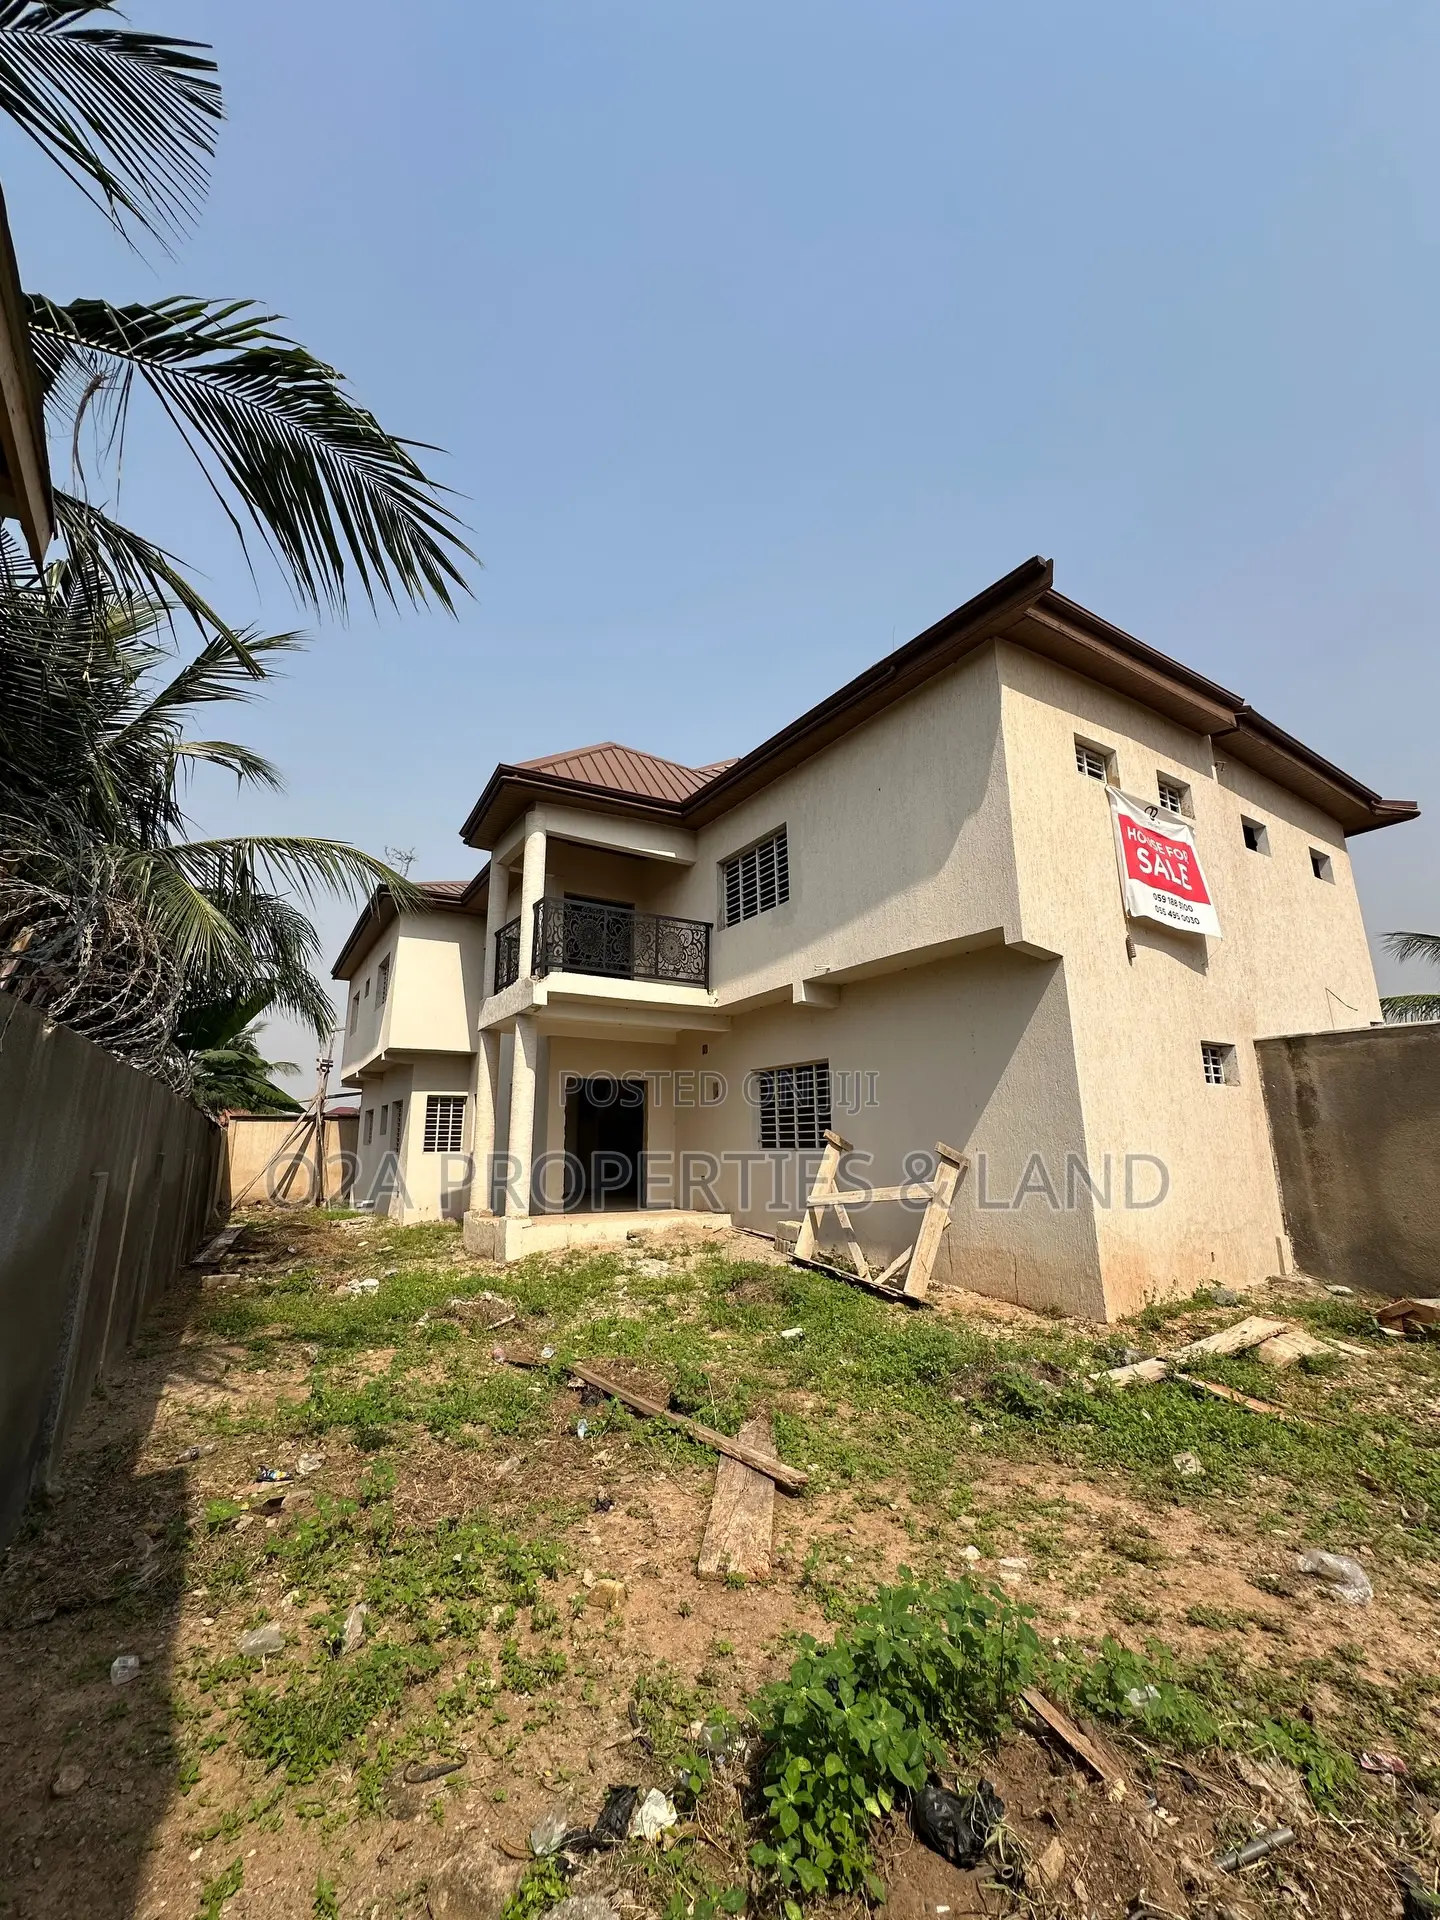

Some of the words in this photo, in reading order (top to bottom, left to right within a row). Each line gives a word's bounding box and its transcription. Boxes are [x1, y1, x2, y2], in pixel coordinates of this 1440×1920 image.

[1127, 826, 1165, 855] HOUSE
[1165, 845, 1189, 864] FOR
[1136, 847, 1193, 890] SALE
